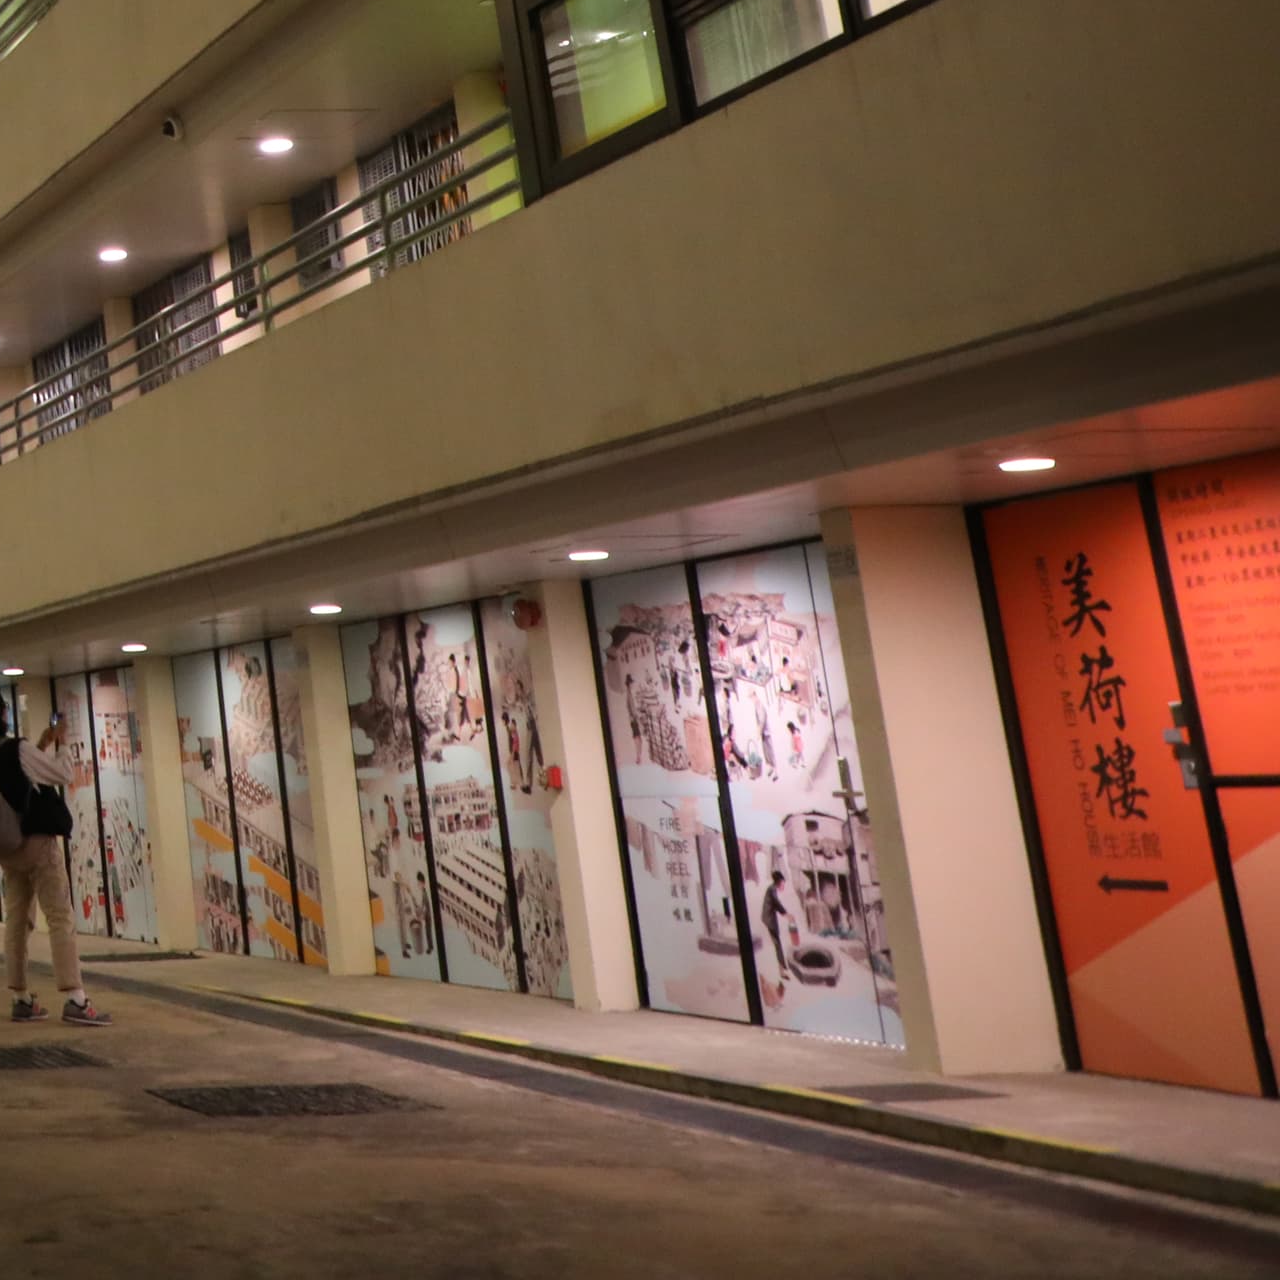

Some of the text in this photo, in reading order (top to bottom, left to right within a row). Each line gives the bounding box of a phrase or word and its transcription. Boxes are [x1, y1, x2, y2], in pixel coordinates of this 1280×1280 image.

[1061, 551, 1149, 821] 美荷樓
[1061, 690, 1079, 727] MEI
[1070, 738, 1086, 771] HO
[659, 817, 681, 831] FIRE
[1077, 781, 1102, 857] HOUSE
[665, 861, 691, 877] REEL
